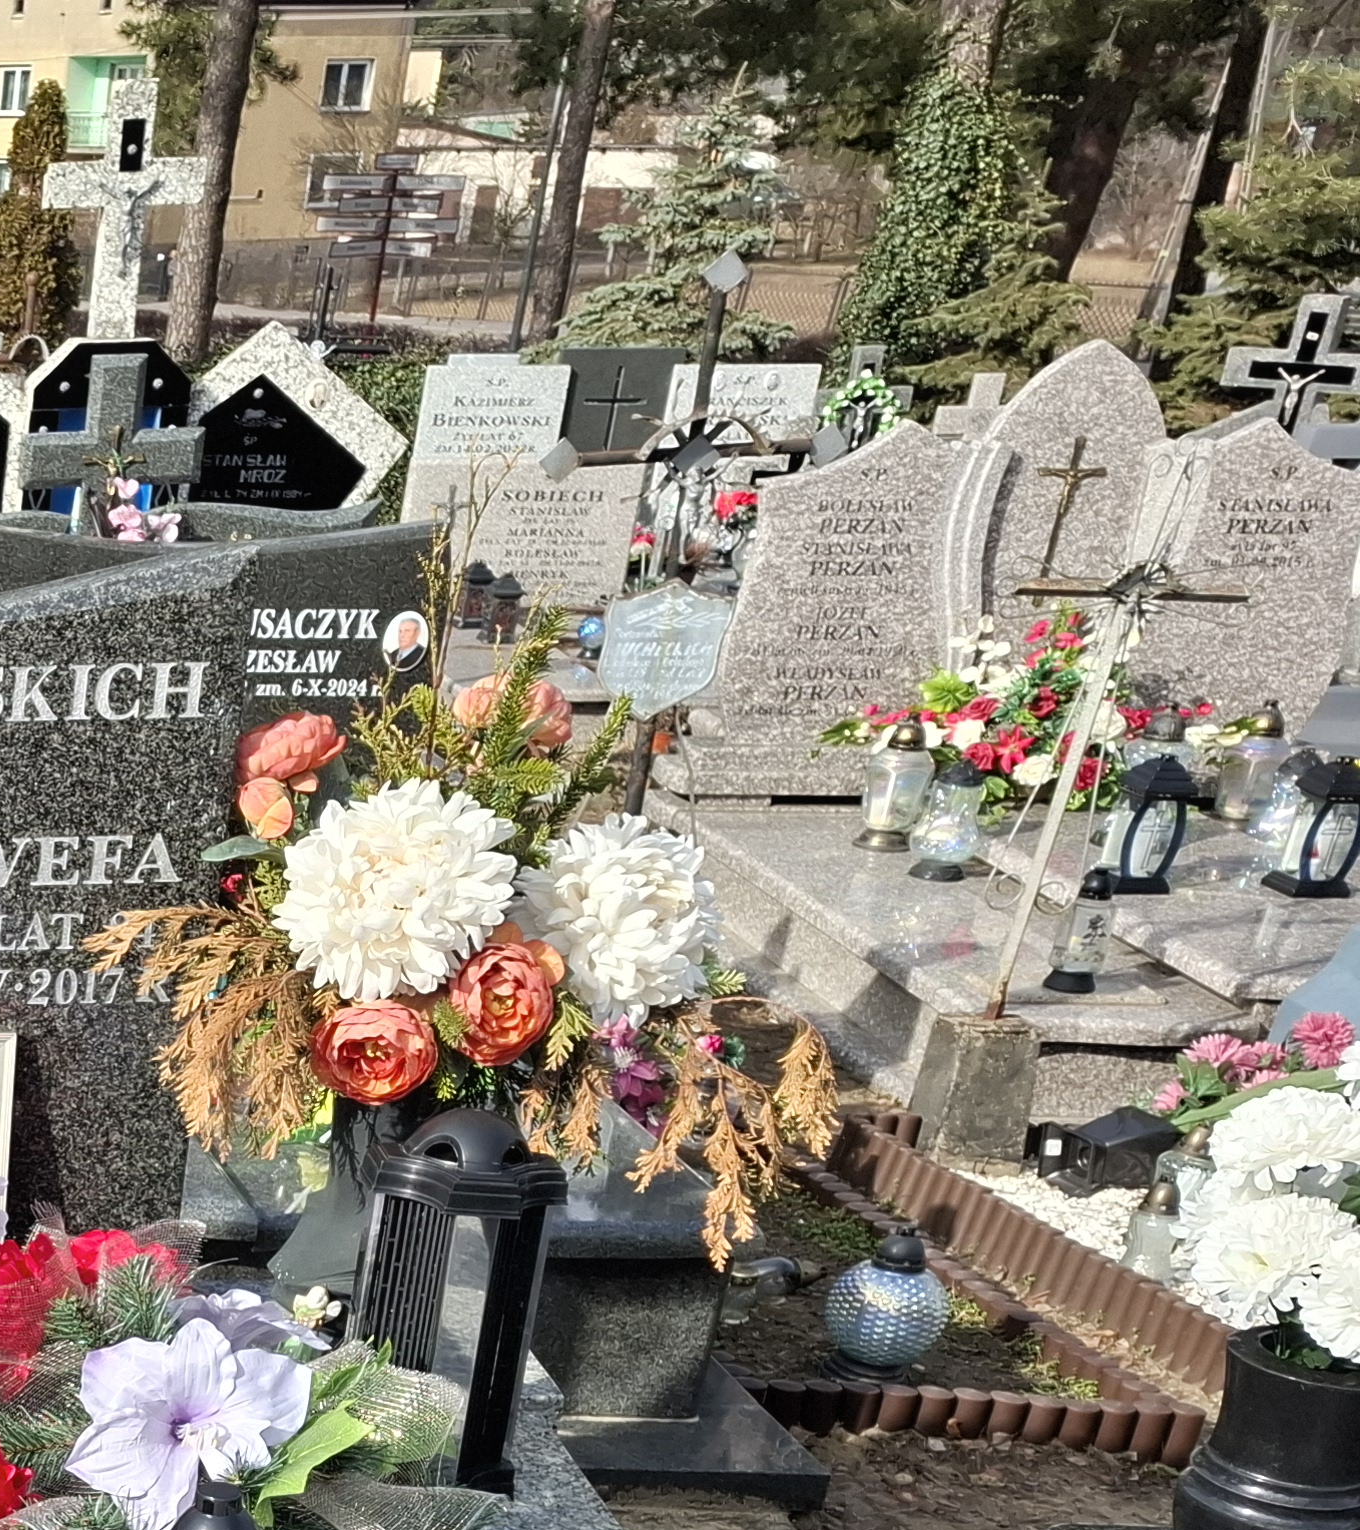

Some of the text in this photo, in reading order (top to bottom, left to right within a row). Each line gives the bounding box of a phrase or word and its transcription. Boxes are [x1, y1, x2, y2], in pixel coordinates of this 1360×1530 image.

[500, 489, 605, 503] SOBIECH
[506, 527, 586, 539] MARIANNA
[247, 647, 343, 674] ZESŁAW
[255, 680, 286, 698] zm.
[292, 678, 369, 698] 6-X-2024
